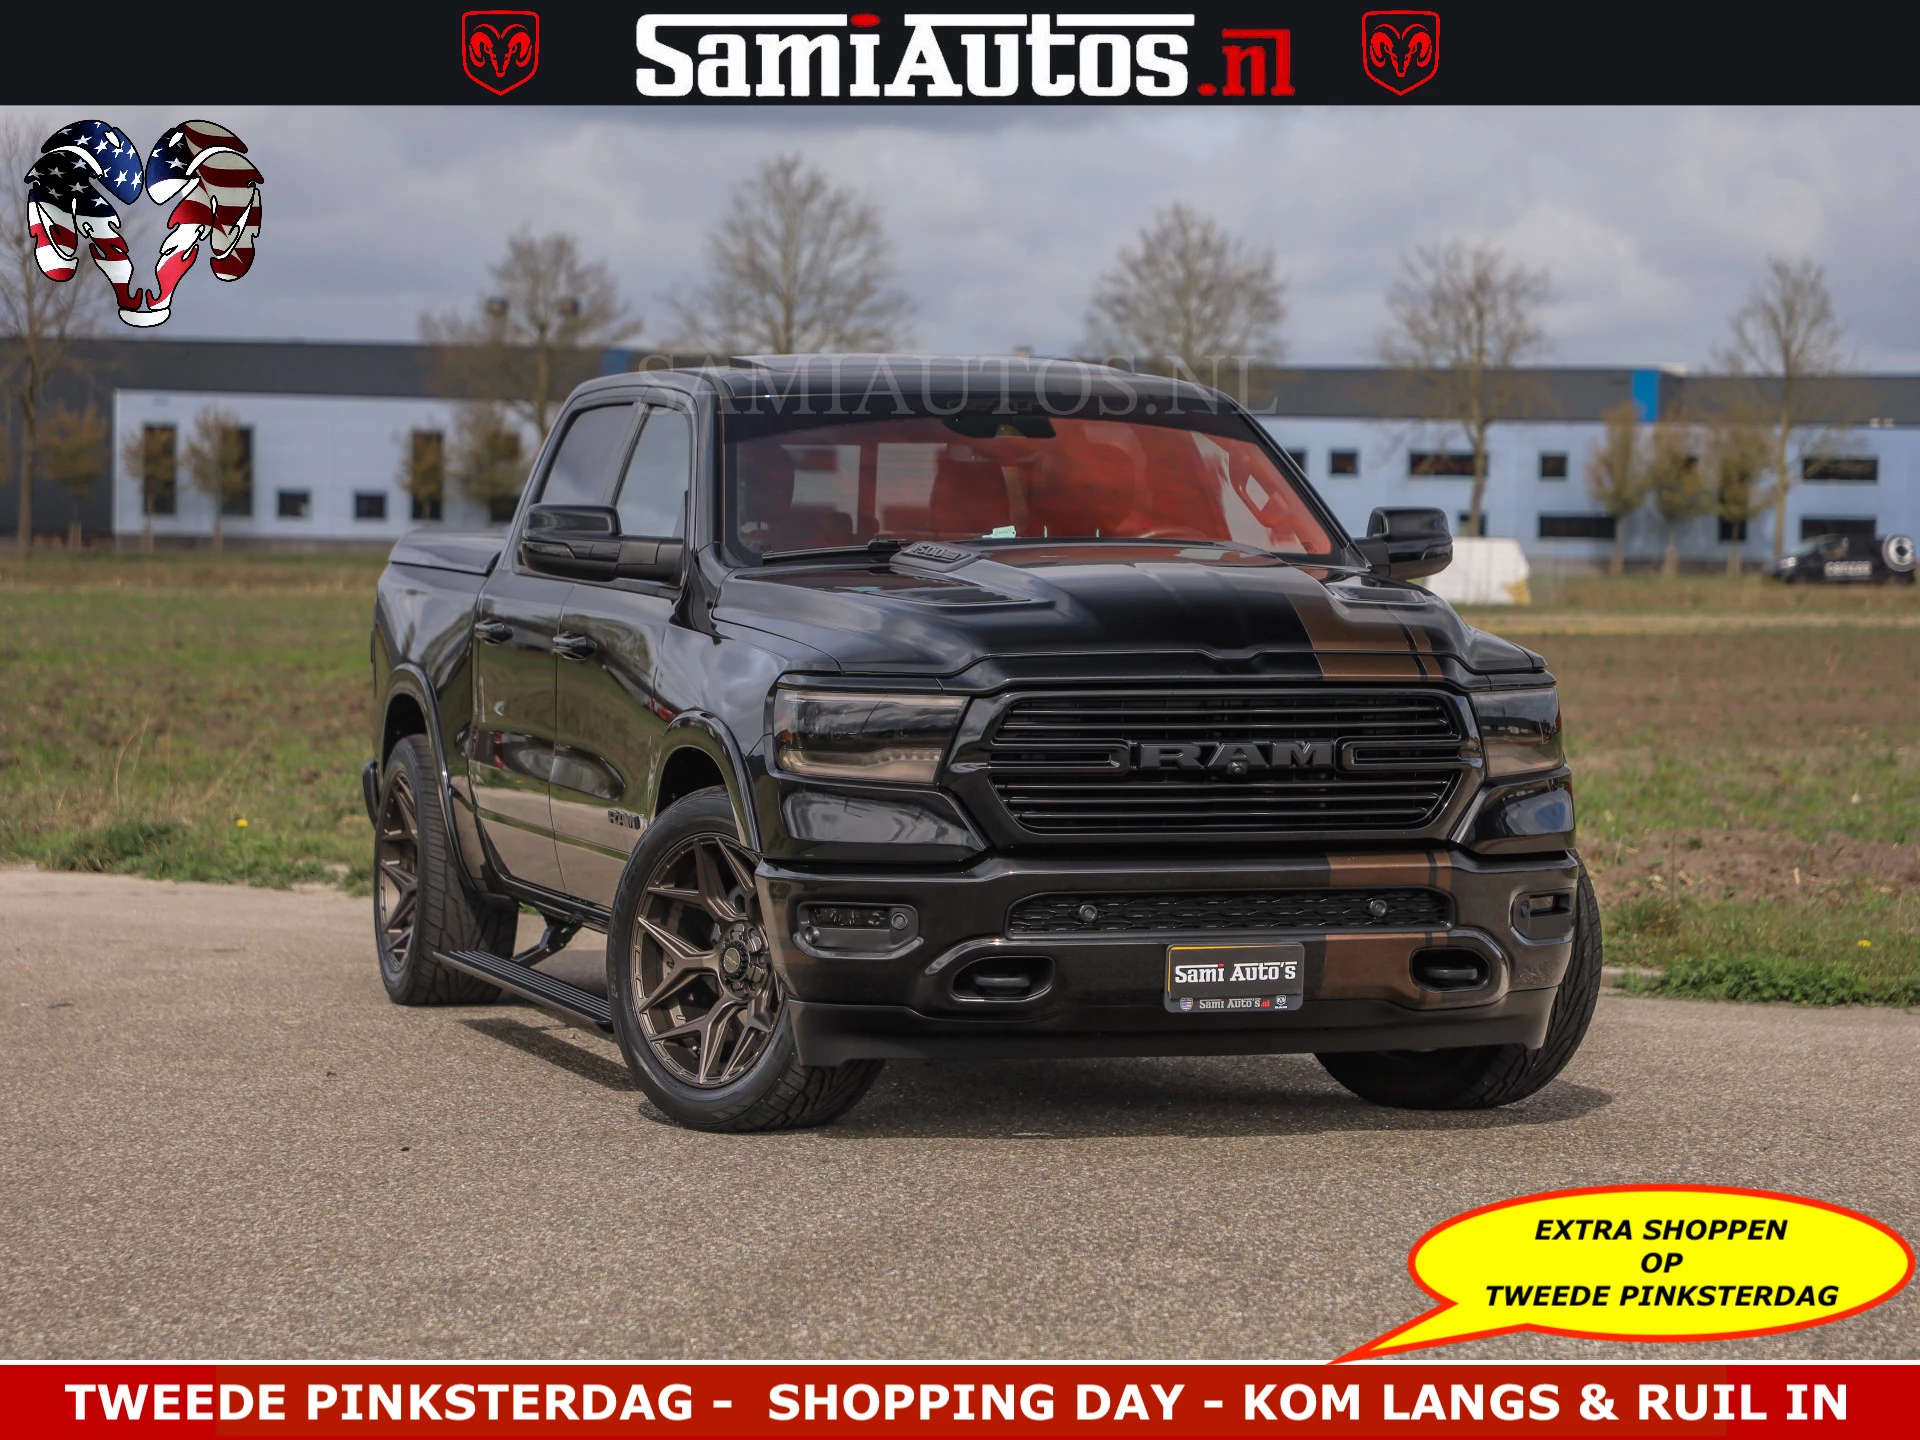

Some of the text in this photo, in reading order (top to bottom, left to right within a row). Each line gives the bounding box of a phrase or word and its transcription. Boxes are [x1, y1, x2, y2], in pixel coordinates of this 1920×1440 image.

[1140, 741, 1333, 768] RAM
[1174, 961, 1298, 984] Sami Auto's
[1199, 998, 1225, 1009] Sami
